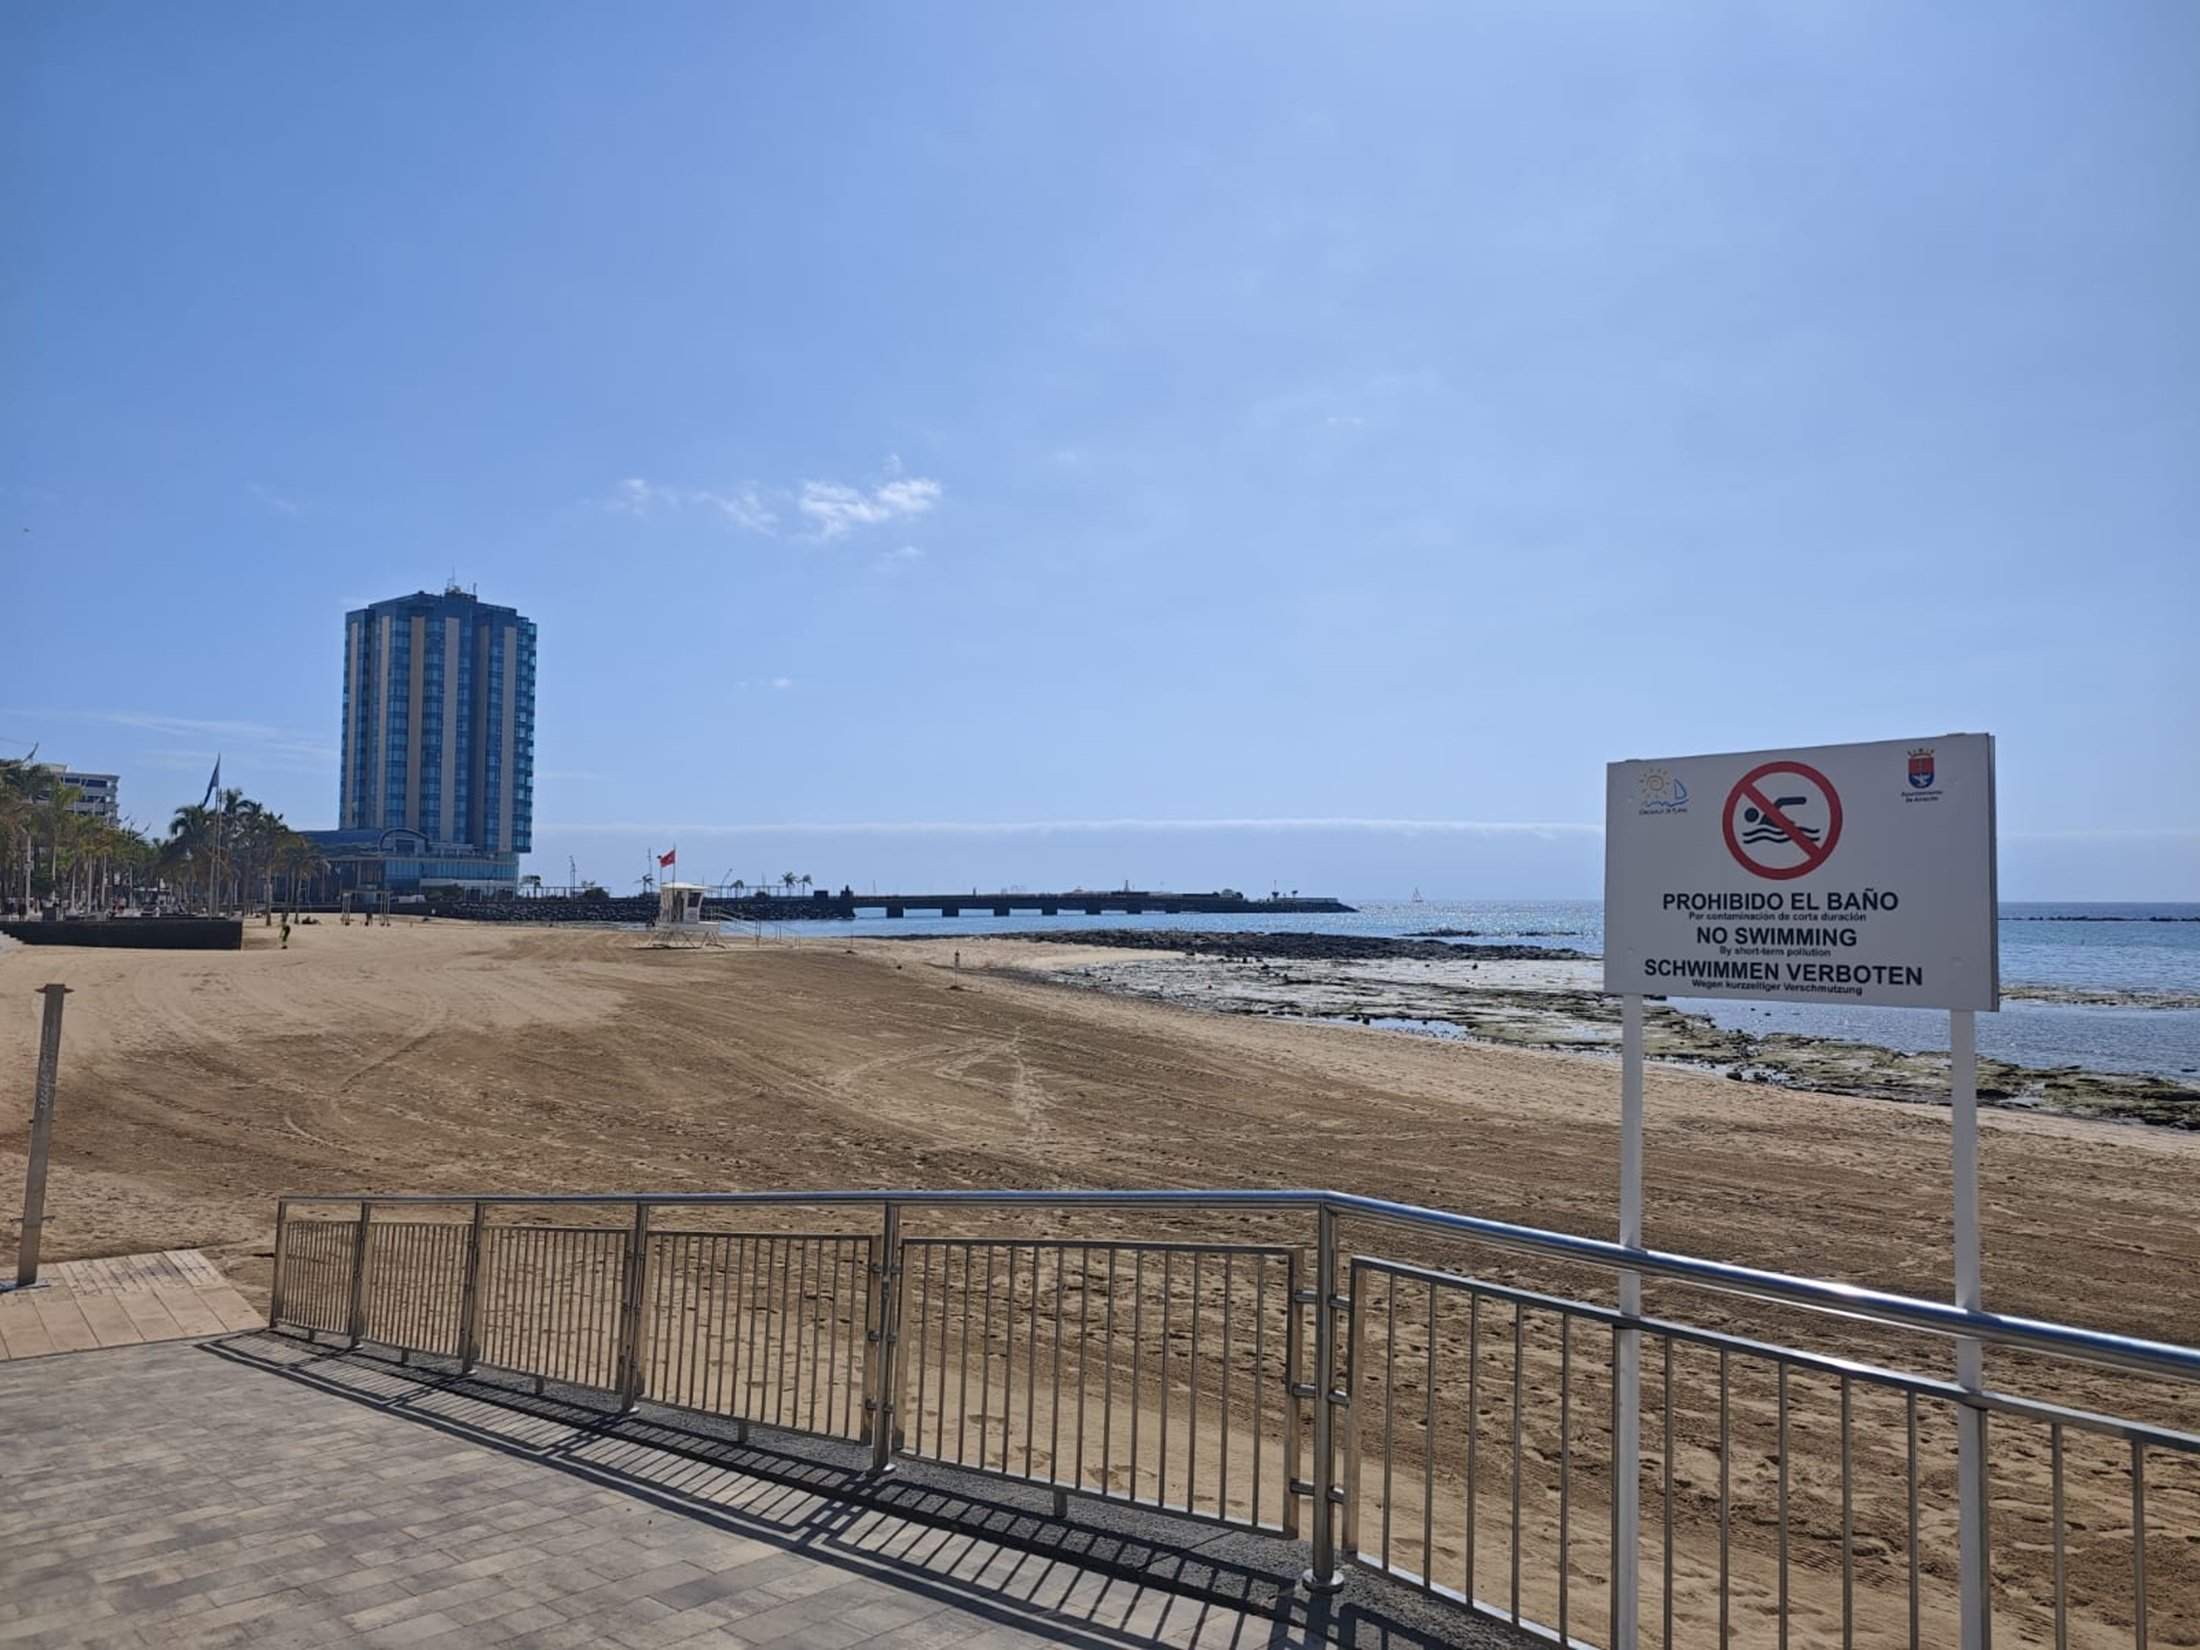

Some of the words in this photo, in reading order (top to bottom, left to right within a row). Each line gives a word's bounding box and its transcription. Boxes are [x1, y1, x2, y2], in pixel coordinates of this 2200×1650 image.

[1663, 892, 1784, 910] PROHIBIDO
[1791, 892, 1820, 910] EL
[1827, 888, 1899, 911] BAÑO
[1689, 911, 1704, 920] Por
[1706, 911, 1775, 921] contaminación
[1778, 912, 1790, 921] de
[1793, 912, 1818, 921] corta
[1821, 911, 1866, 921] duración
[1696, 927, 1728, 944] NO
[1734, 927, 1857, 947] SWIMMING
[1720, 946, 1732, 956] By
[1734, 946, 1784, 956] short-term
[1787, 947, 1832, 957] pollution
[1644, 958, 1779, 981] SCHWIMMEN
[1786, 963, 1922, 986] VERBOTEN
[1691, 979, 1723, 990] Wegen
[1725, 980, 1781, 992] kurzzeitiger
[1783, 982, 1863, 996] Verschmutzung
